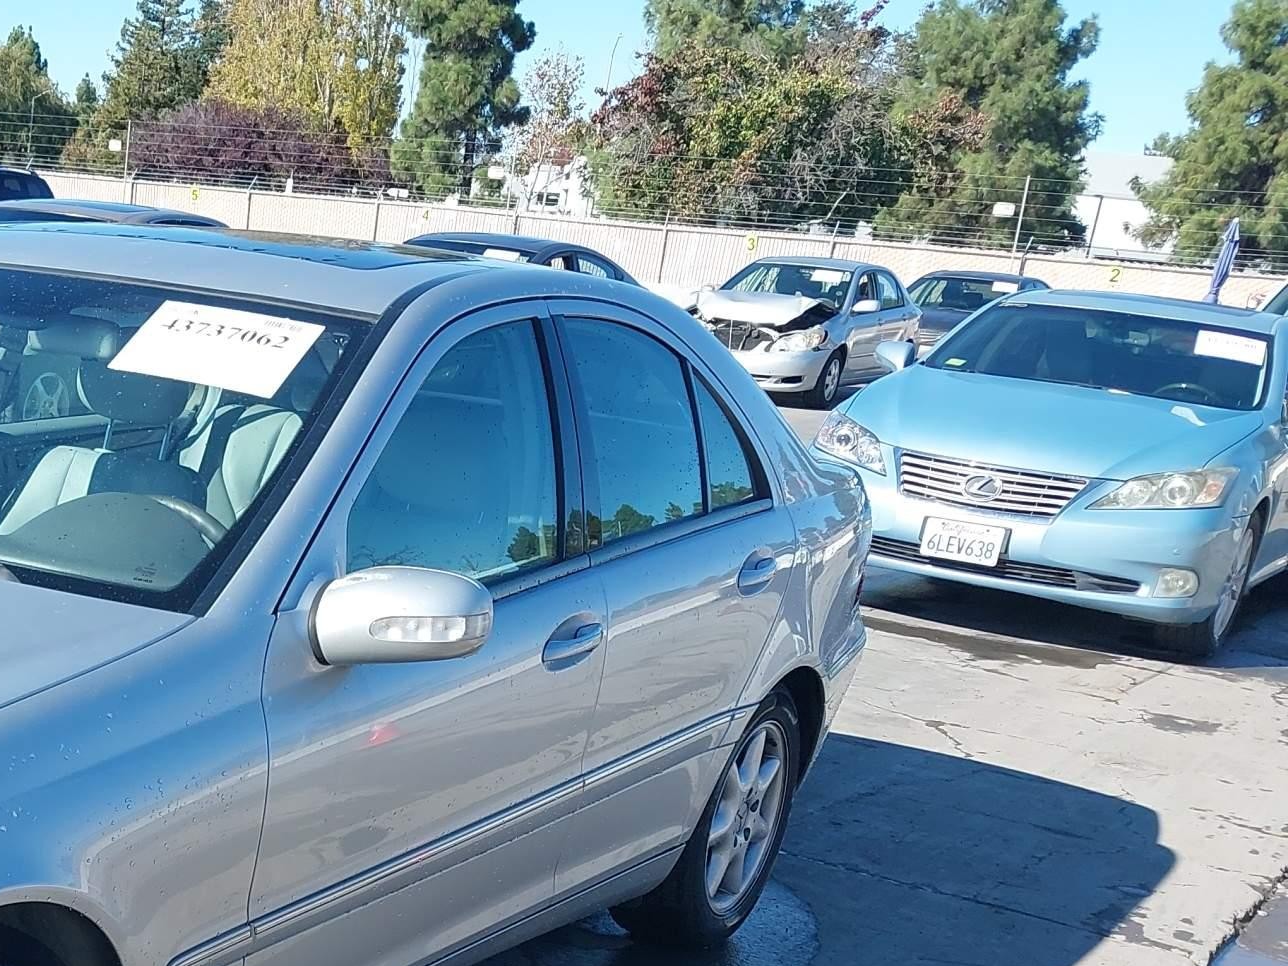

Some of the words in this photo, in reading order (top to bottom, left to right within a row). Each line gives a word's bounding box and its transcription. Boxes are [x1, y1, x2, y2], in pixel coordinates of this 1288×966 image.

[191, 189, 199, 201] 5
[422, 209, 429, 221] 4
[747, 237, 755, 251] 3
[1109, 268, 1121, 283] 2
[160, 318, 290, 349] 43737062
[926, 532, 996, 560] 6LEV638
